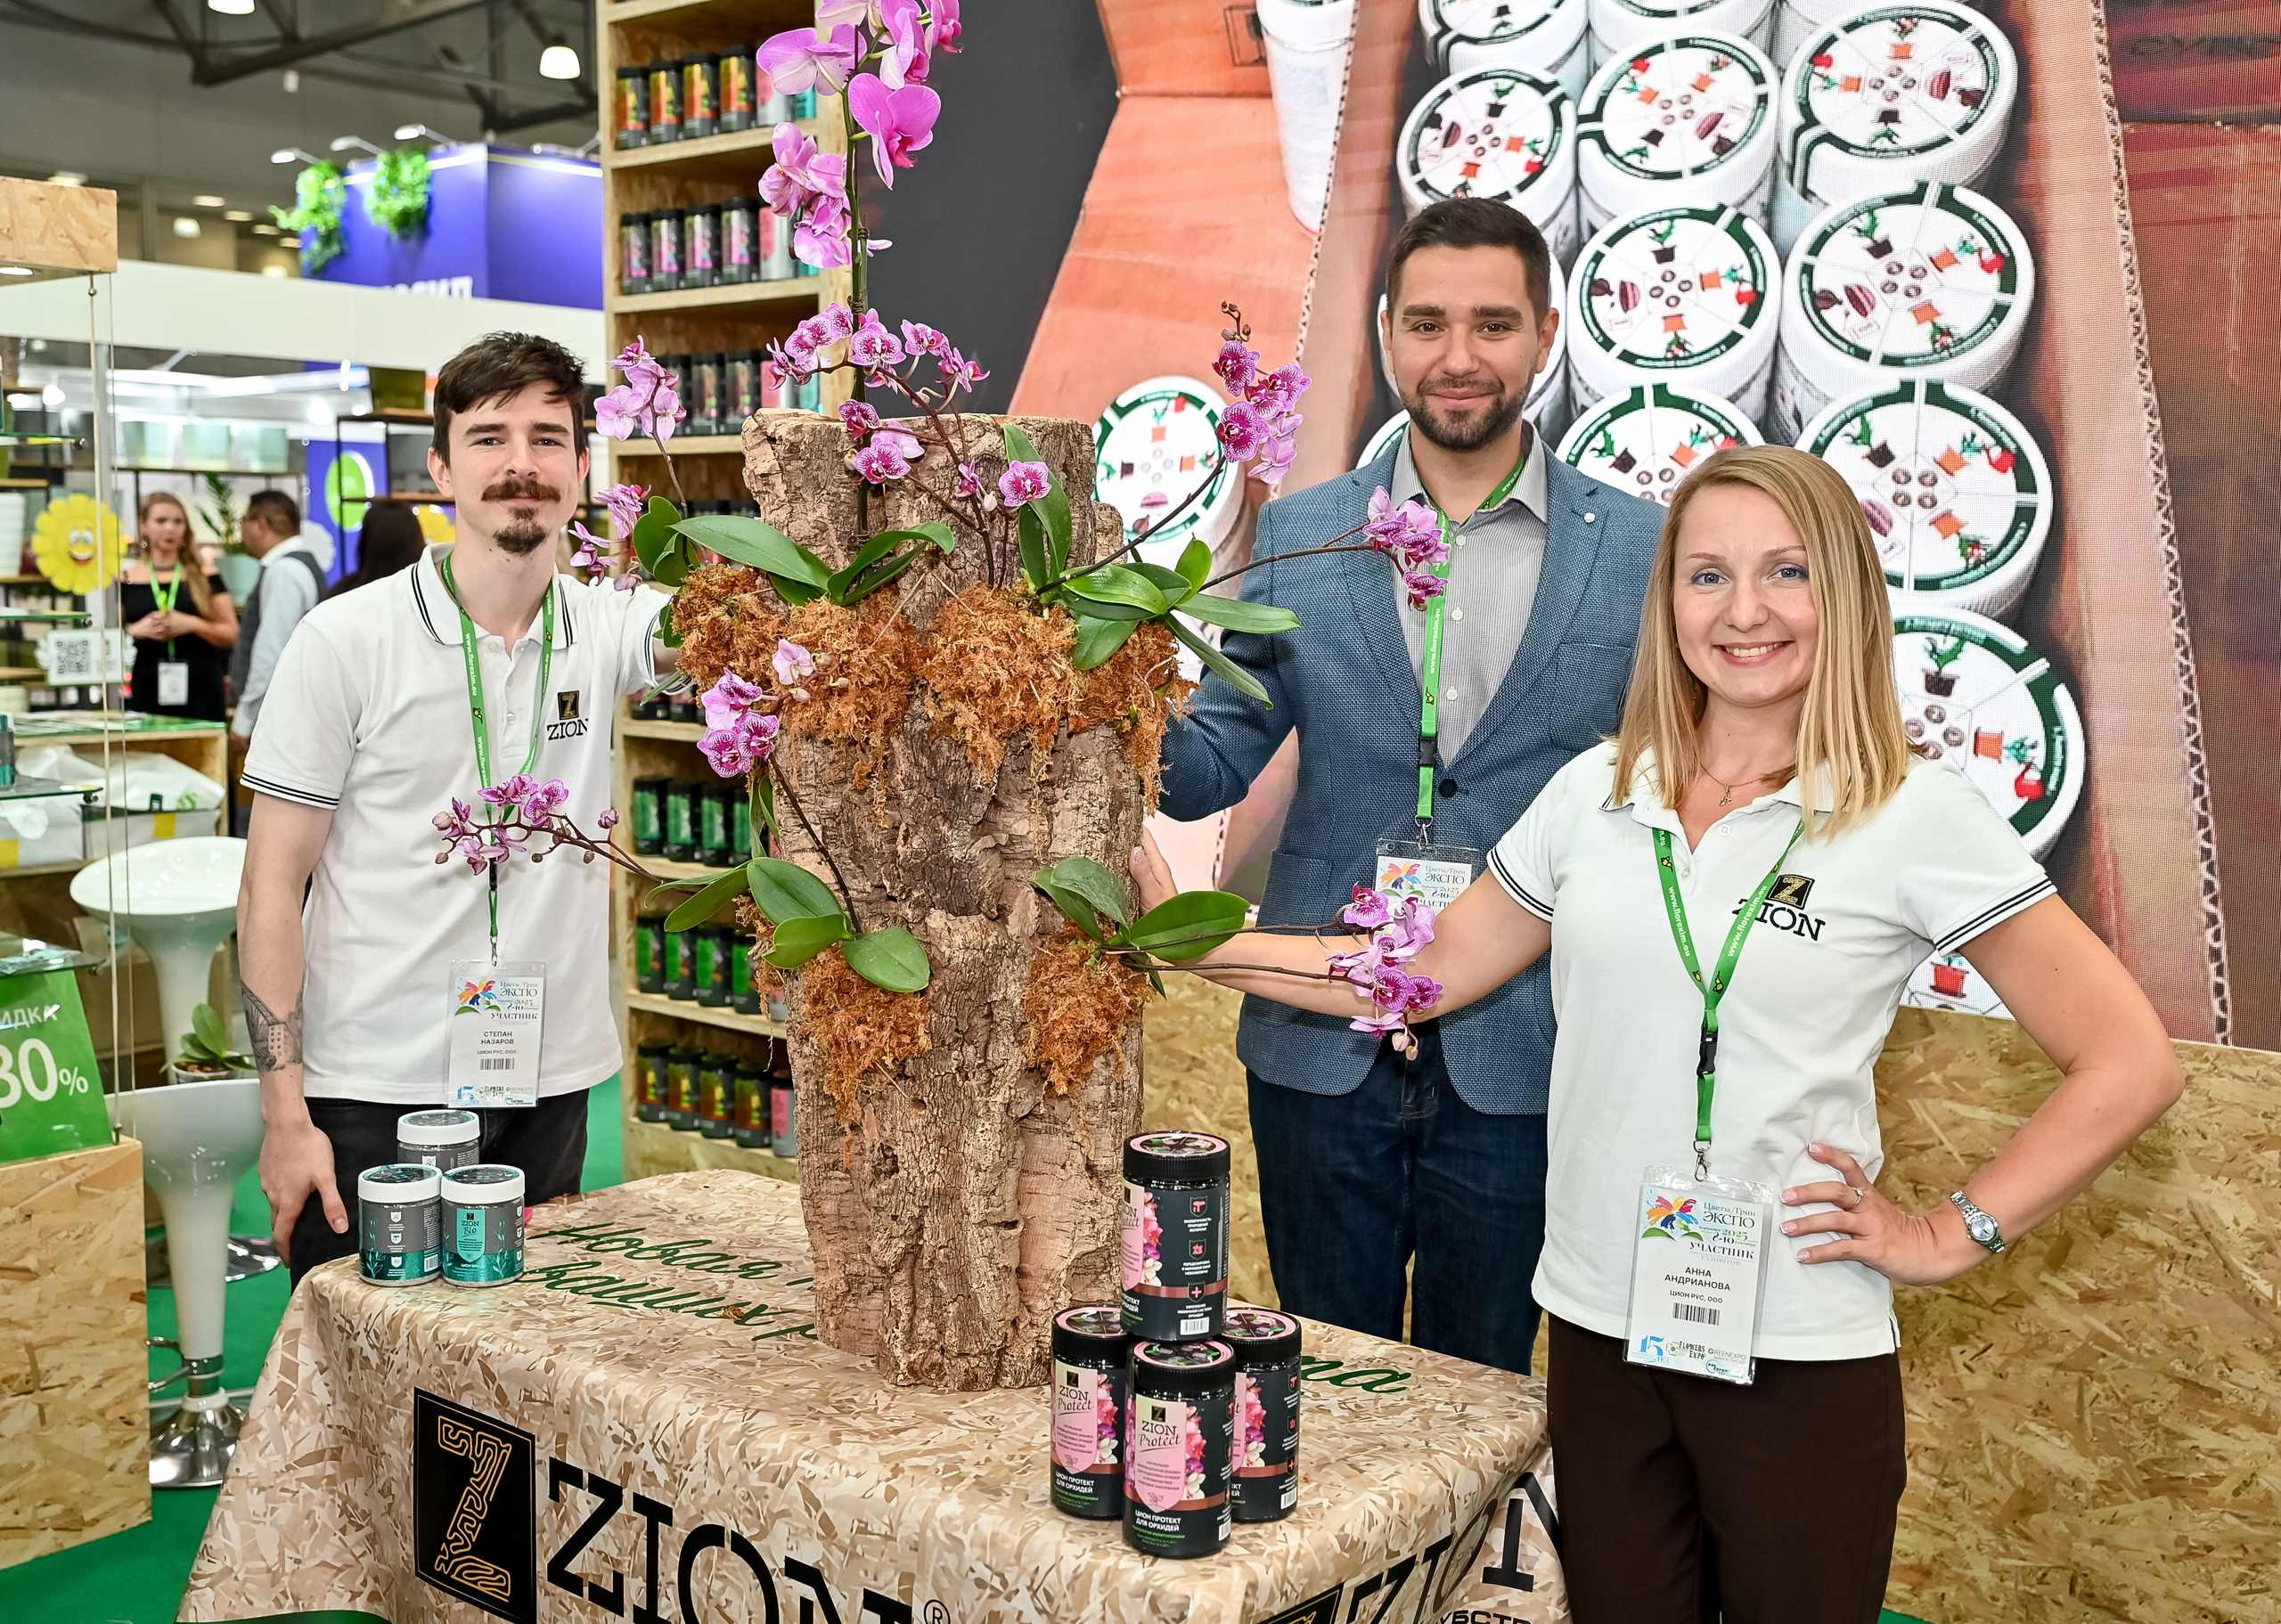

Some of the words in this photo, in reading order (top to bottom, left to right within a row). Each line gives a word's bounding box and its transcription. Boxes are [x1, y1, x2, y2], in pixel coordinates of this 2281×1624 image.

[465, 633, 478, 697] www.florexim.eu
[478, 737, 487, 788] www.florexim
[1424, 873, 1465, 885] ЭКСПО
[1668, 886, 1691, 958] www.florexim.eu
[1728, 885, 1768, 958] www.florexim.eu
[500, 988, 538, 997] ЭКСПО
[1703, 1211, 1755, 1228] ЭКСПО
[1721, 1228, 1748, 1241] 2025
[1689, 1242, 1754, 1260] УЧАСТНИК
[1684, 1266, 1712, 1277] АННА
[1664, 1274, 1731, 1291] АНДРИАНОВА
[1669, 1290, 1689, 1298] ЦИОН
[1690, 1293, 1706, 1302] РУС,
[1059, 1385, 1090, 1402] ZION
[1057, 1398, 1094, 1411] Protect
[1141, 1420, 1177, 1436] ZION
[1137, 1433, 1182, 1448] Protect
[1065, 1482, 1093, 1493] ОРХИДЕЙ
[1068, 1476, 1094, 1486] ПРОТЕКТ
[1134, 1509, 1151, 1520] ЦИОН
[1152, 1514, 1181, 1524] ПРОТЕКТ
[1136, 1518, 1148, 1527] ДЛЯ
[1148, 1522, 1180, 1531] ОРХИДЕЙ
